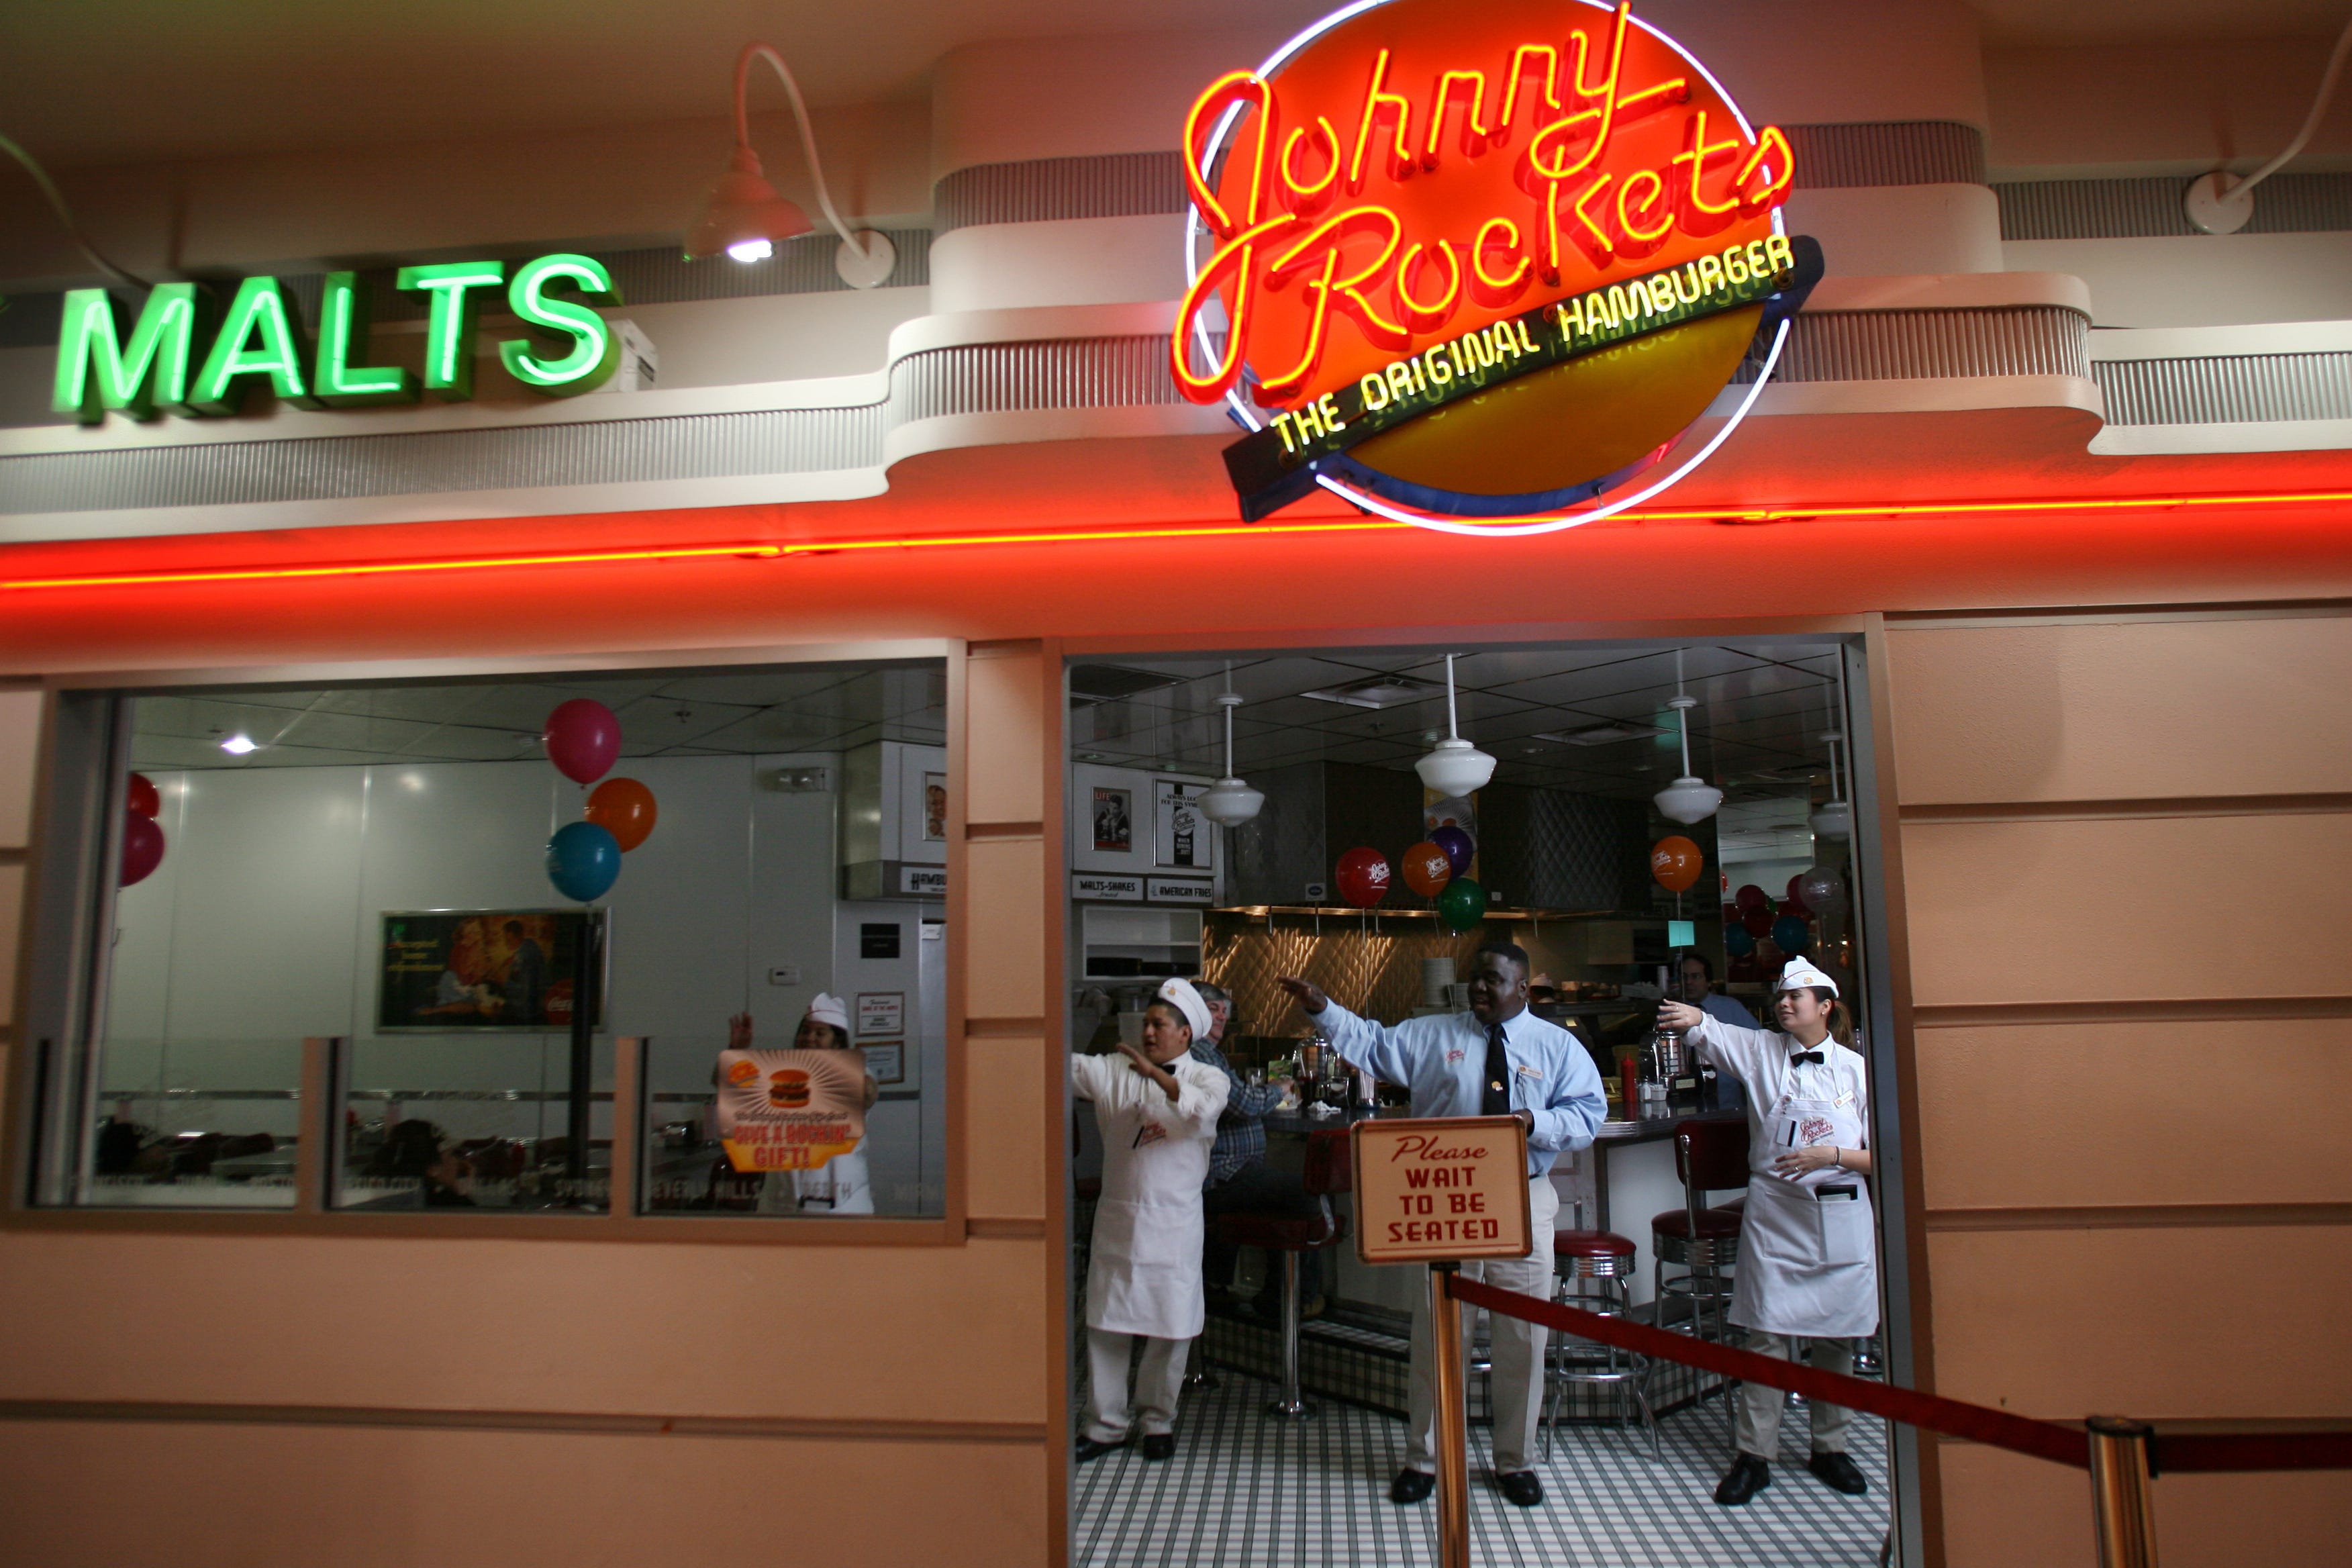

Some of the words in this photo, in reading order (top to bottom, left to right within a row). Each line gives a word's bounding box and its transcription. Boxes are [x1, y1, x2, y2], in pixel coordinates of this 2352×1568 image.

[1174, 2, 1686, 387] Johnny
[1261, 113, 1794, 389] Rockets
[54, 254, 614, 418] MALTS
[1270, 392, 1346, 453] THE
[1360, 319, 1540, 411] ORIGINAL
[1557, 234, 1794, 342] HAMBURGER
[1096, 791, 1111, 801] LIFE
[1080, 881, 1136, 891] MALTS-SHAKES
[1159, 886, 1193, 897] AMERICAN
[1194, 888, 1212, 897] FRIES
[735, 1124, 769, 1144] GIVE
[773, 1124, 783, 1144] A
[1805, 1123, 1833, 1141] Rockets
[753, 1146, 810, 1167] GIFT!
[1391, 1135, 1489, 1163] Please
[1405, 1166, 1476, 1189] WAIT
[1398, 1194, 1434, 1216] TO
[1447, 1192, 1485, 1214] BE
[1387, 1218, 1499, 1242] SEATED
